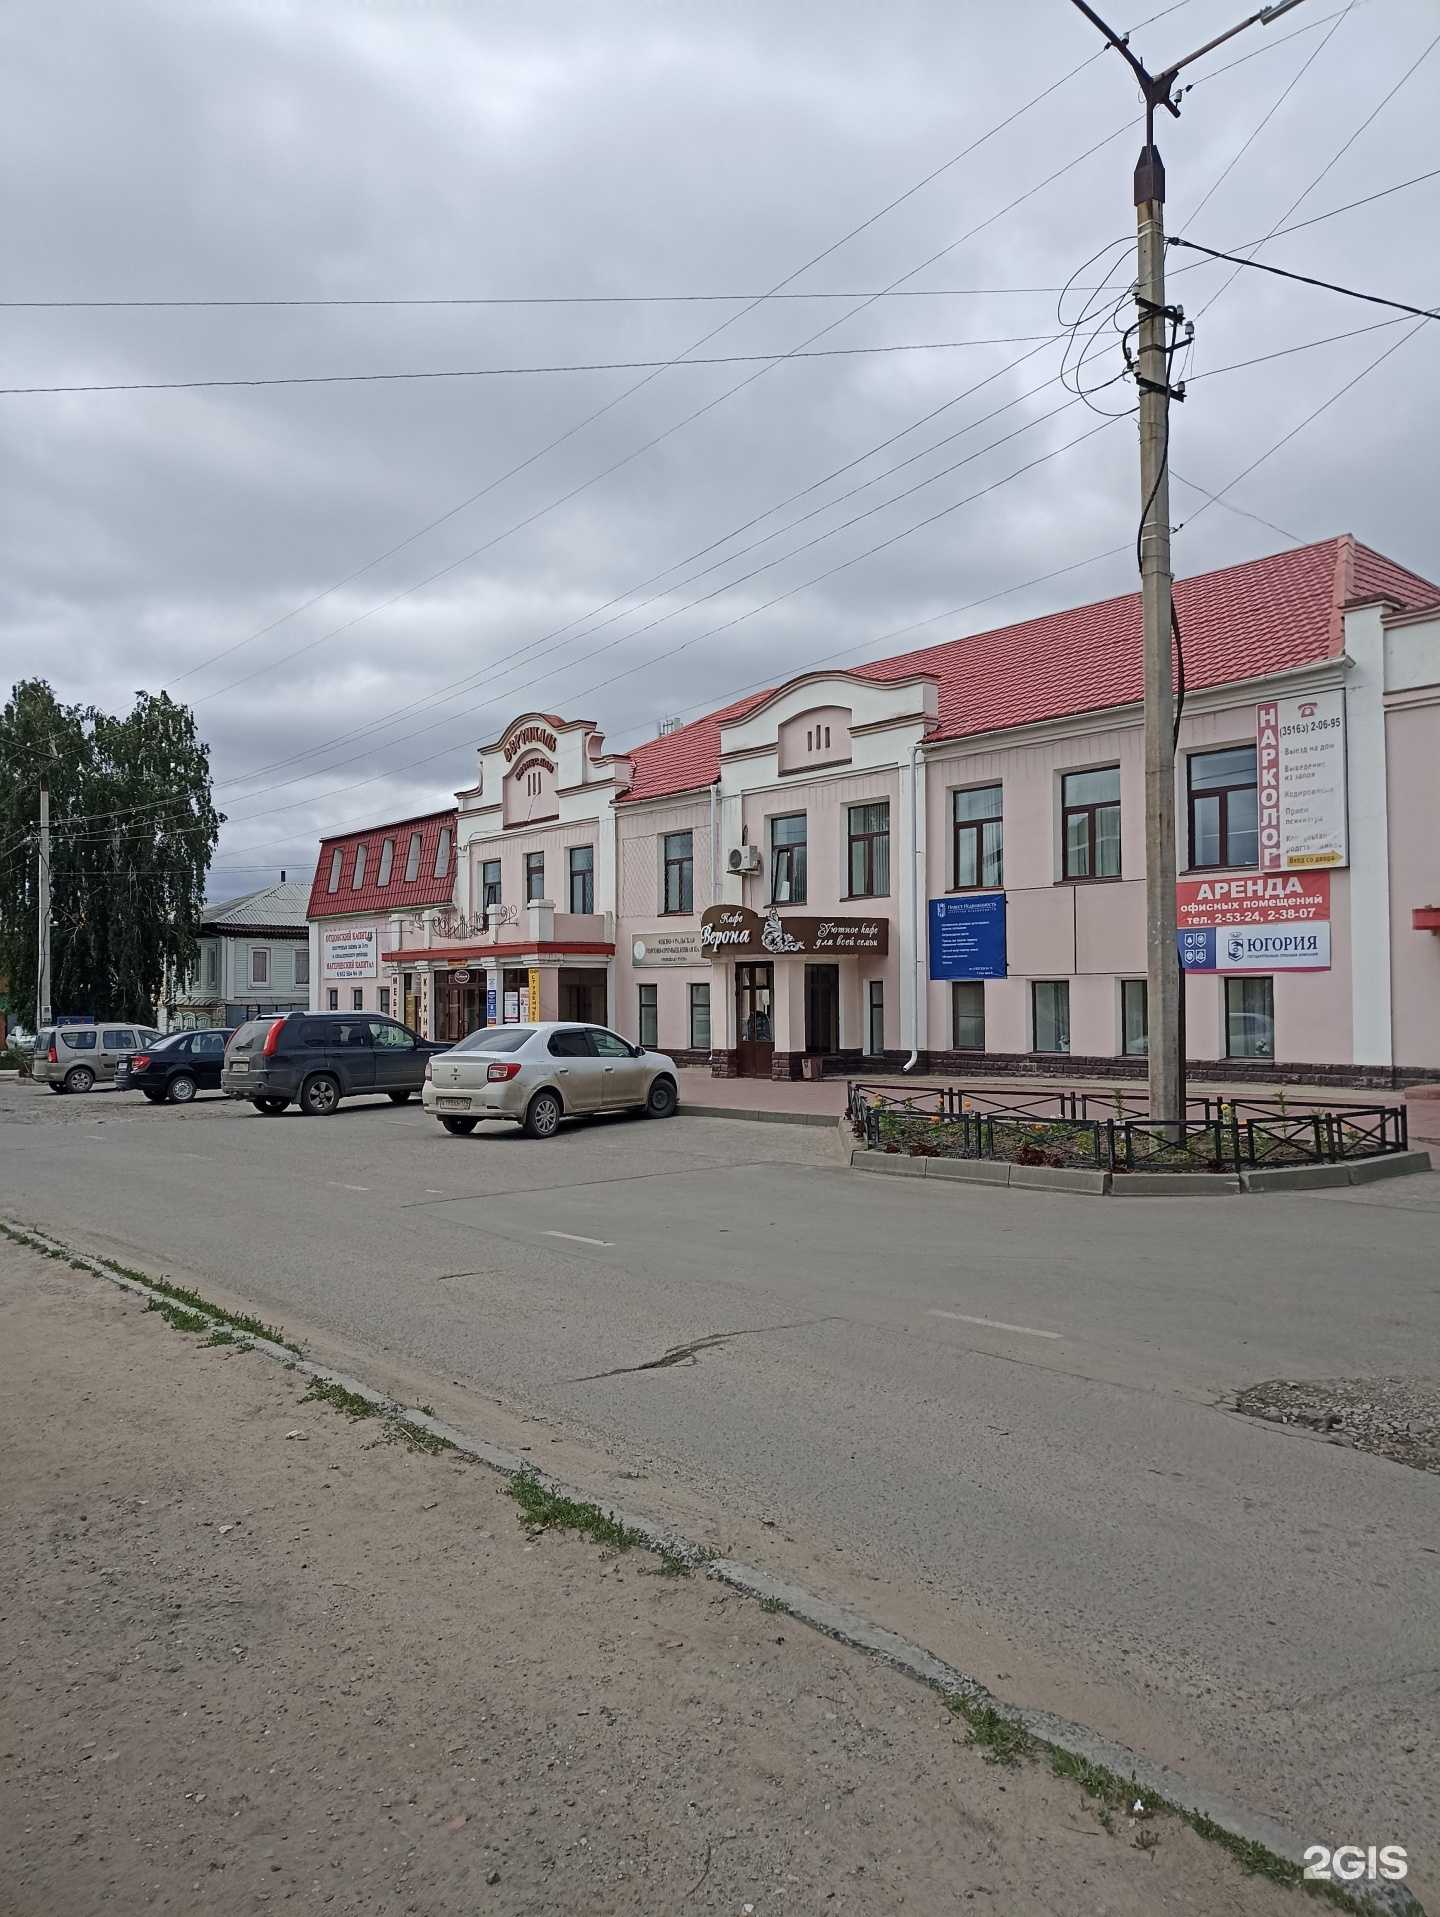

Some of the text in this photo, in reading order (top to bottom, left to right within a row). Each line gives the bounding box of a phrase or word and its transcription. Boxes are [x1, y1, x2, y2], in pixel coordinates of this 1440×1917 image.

[1311, 717, 1341, 731] 2-06-95
[1259, 708, 1280, 867] НАРКОЛОГ
[1196, 877, 1304, 900] АРЕНДА
[1180, 895, 1323, 914] офисных помещений
[720, 910, 743, 926] Кафе
[1187, 908, 1315, 925] тел. 2-53-24, 2-38-07
[701, 923, 751, 952] Верона
[818, 922, 878, 937] Уютное кафе
[813, 939, 834, 949] для
[836, 935, 855, 946] всей
[1247, 935, 1318, 952] ЮГОРИЯ
